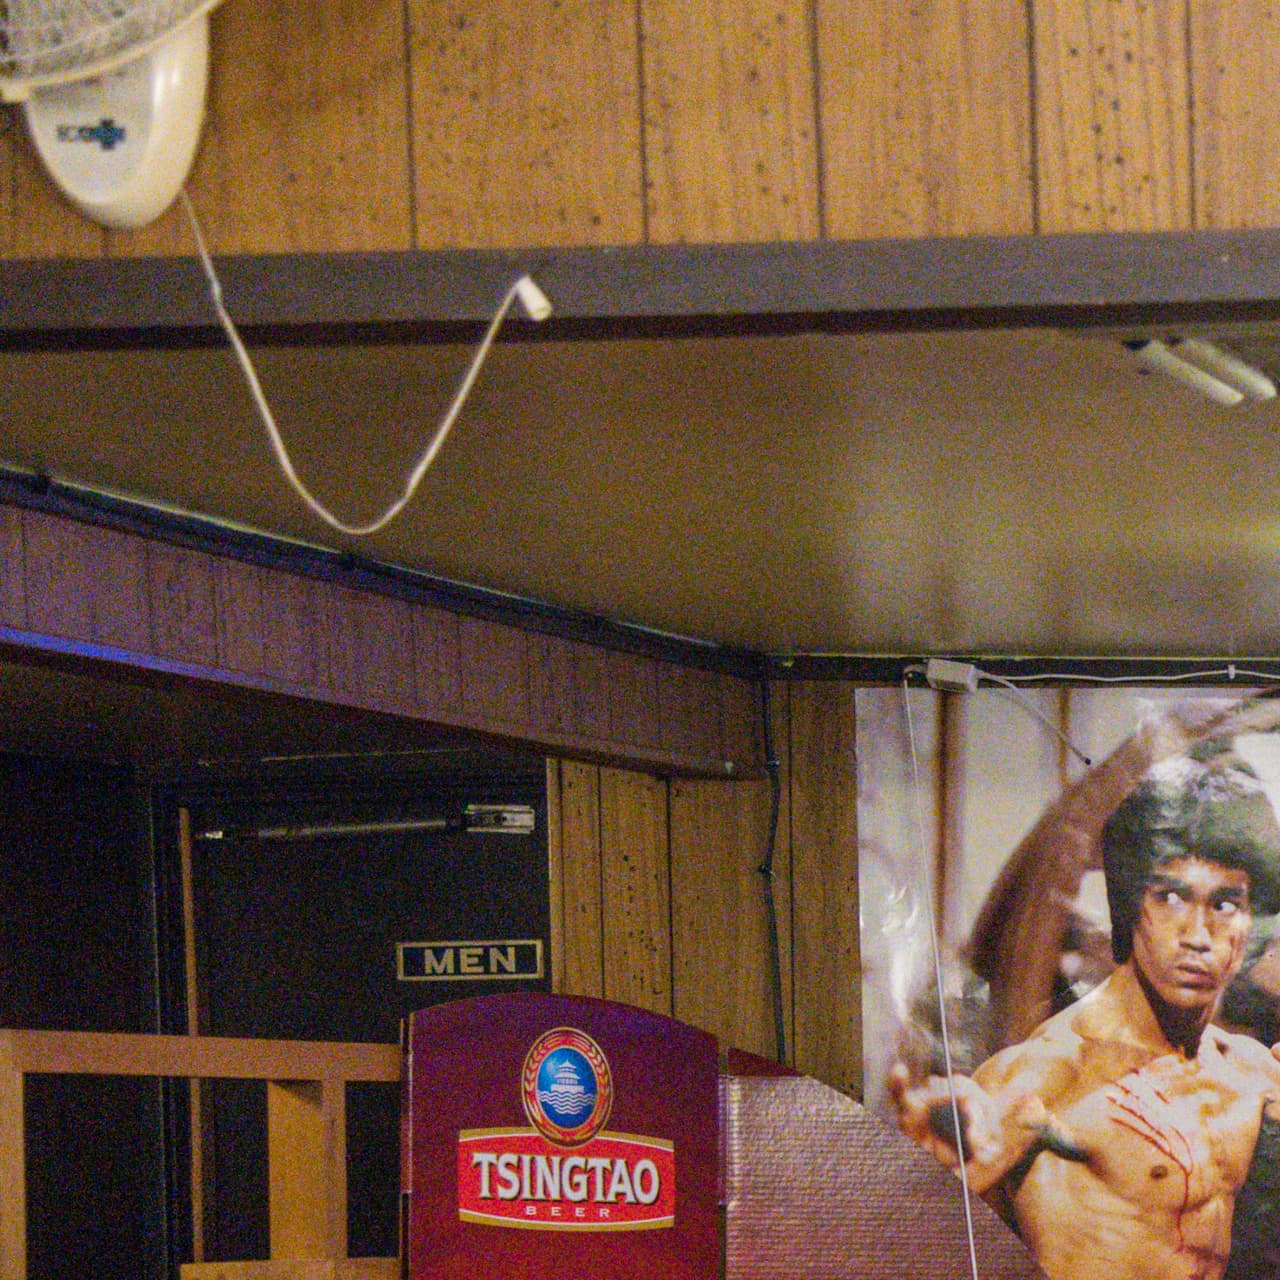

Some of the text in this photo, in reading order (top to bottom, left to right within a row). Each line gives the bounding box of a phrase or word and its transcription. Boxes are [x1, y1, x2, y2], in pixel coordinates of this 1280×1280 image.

[425, 947, 516, 974] MEN
[473, 1152, 660, 1205] TSINGTAO
[525, 1205, 611, 1218] BEER
